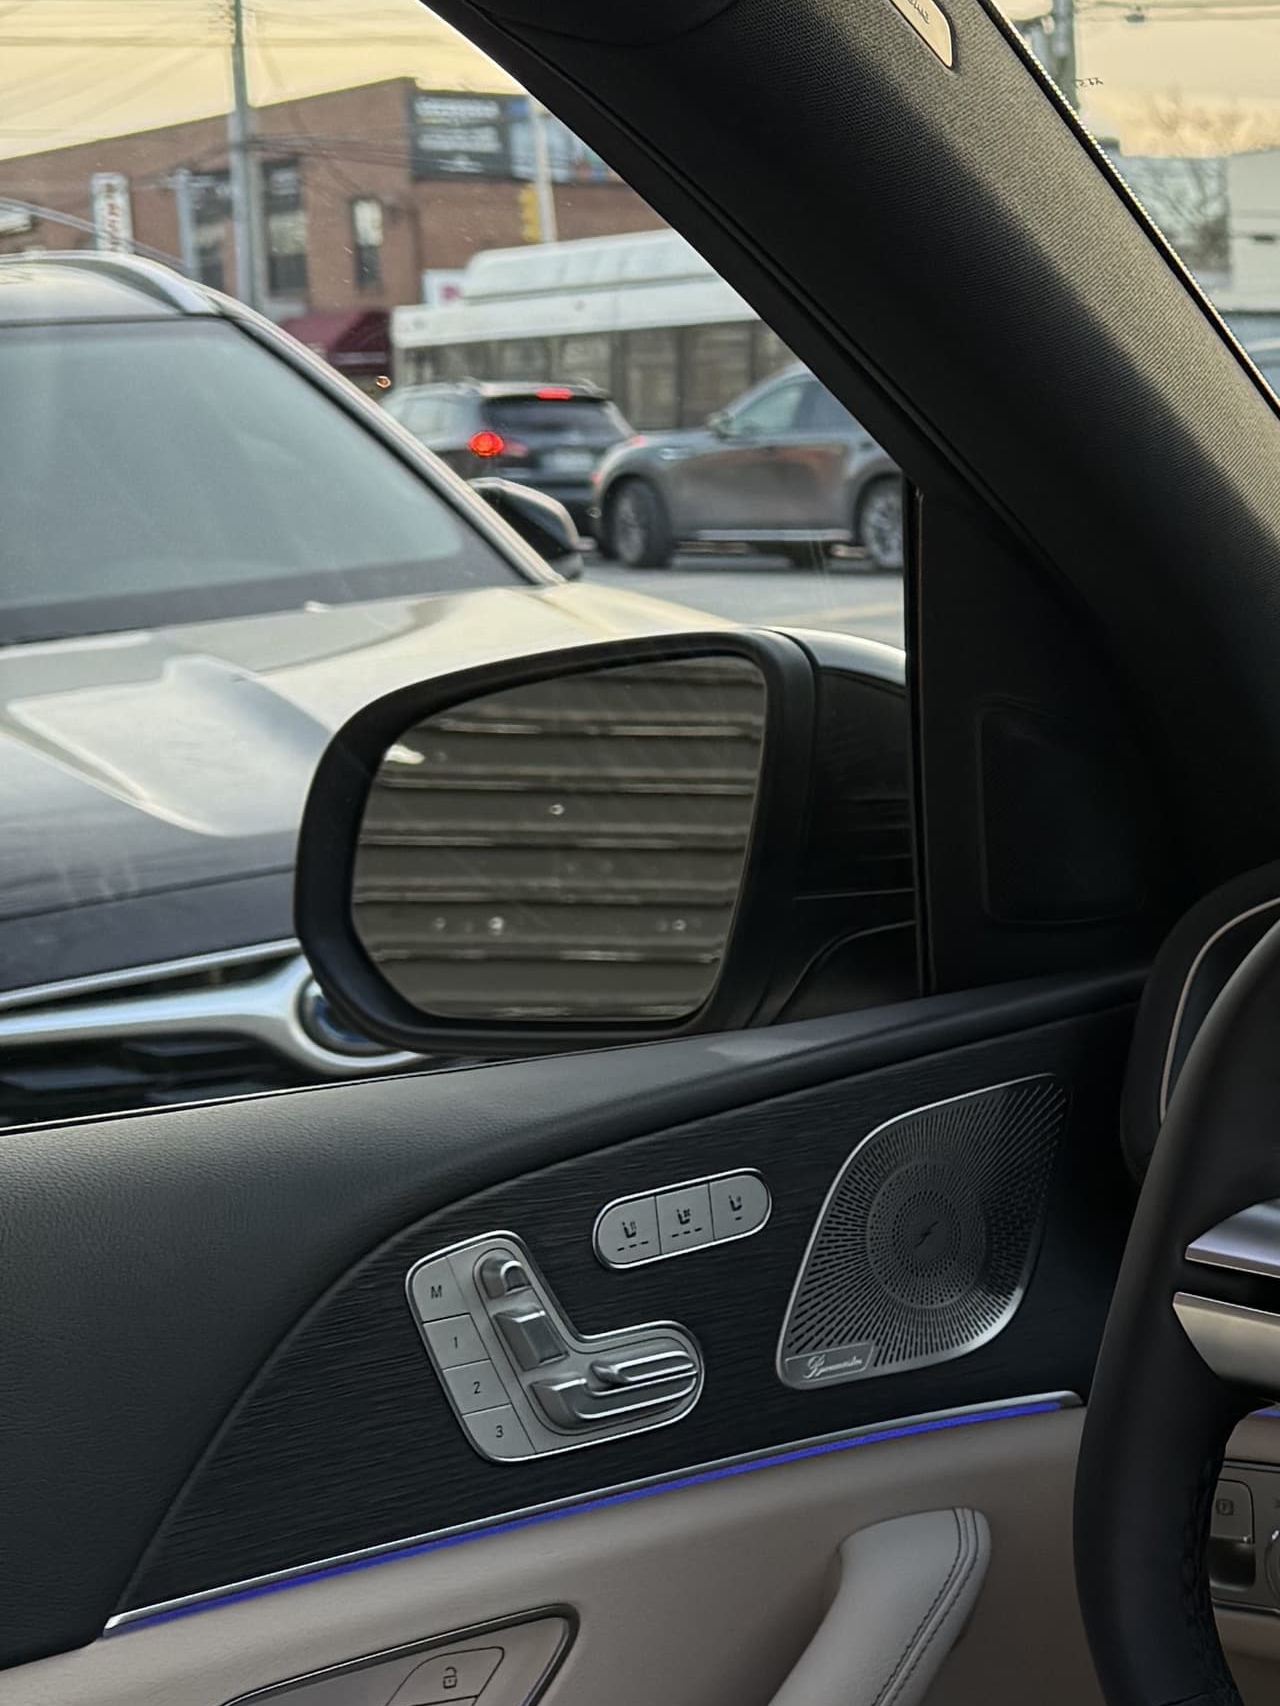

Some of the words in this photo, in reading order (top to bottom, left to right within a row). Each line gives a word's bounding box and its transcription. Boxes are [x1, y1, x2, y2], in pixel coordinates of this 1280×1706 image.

[430, 1285, 442, 1299] M
[453, 1336, 459, 1349] 1
[473, 1381, 481, 1395] 2
[495, 1425, 504, 1438] 3
